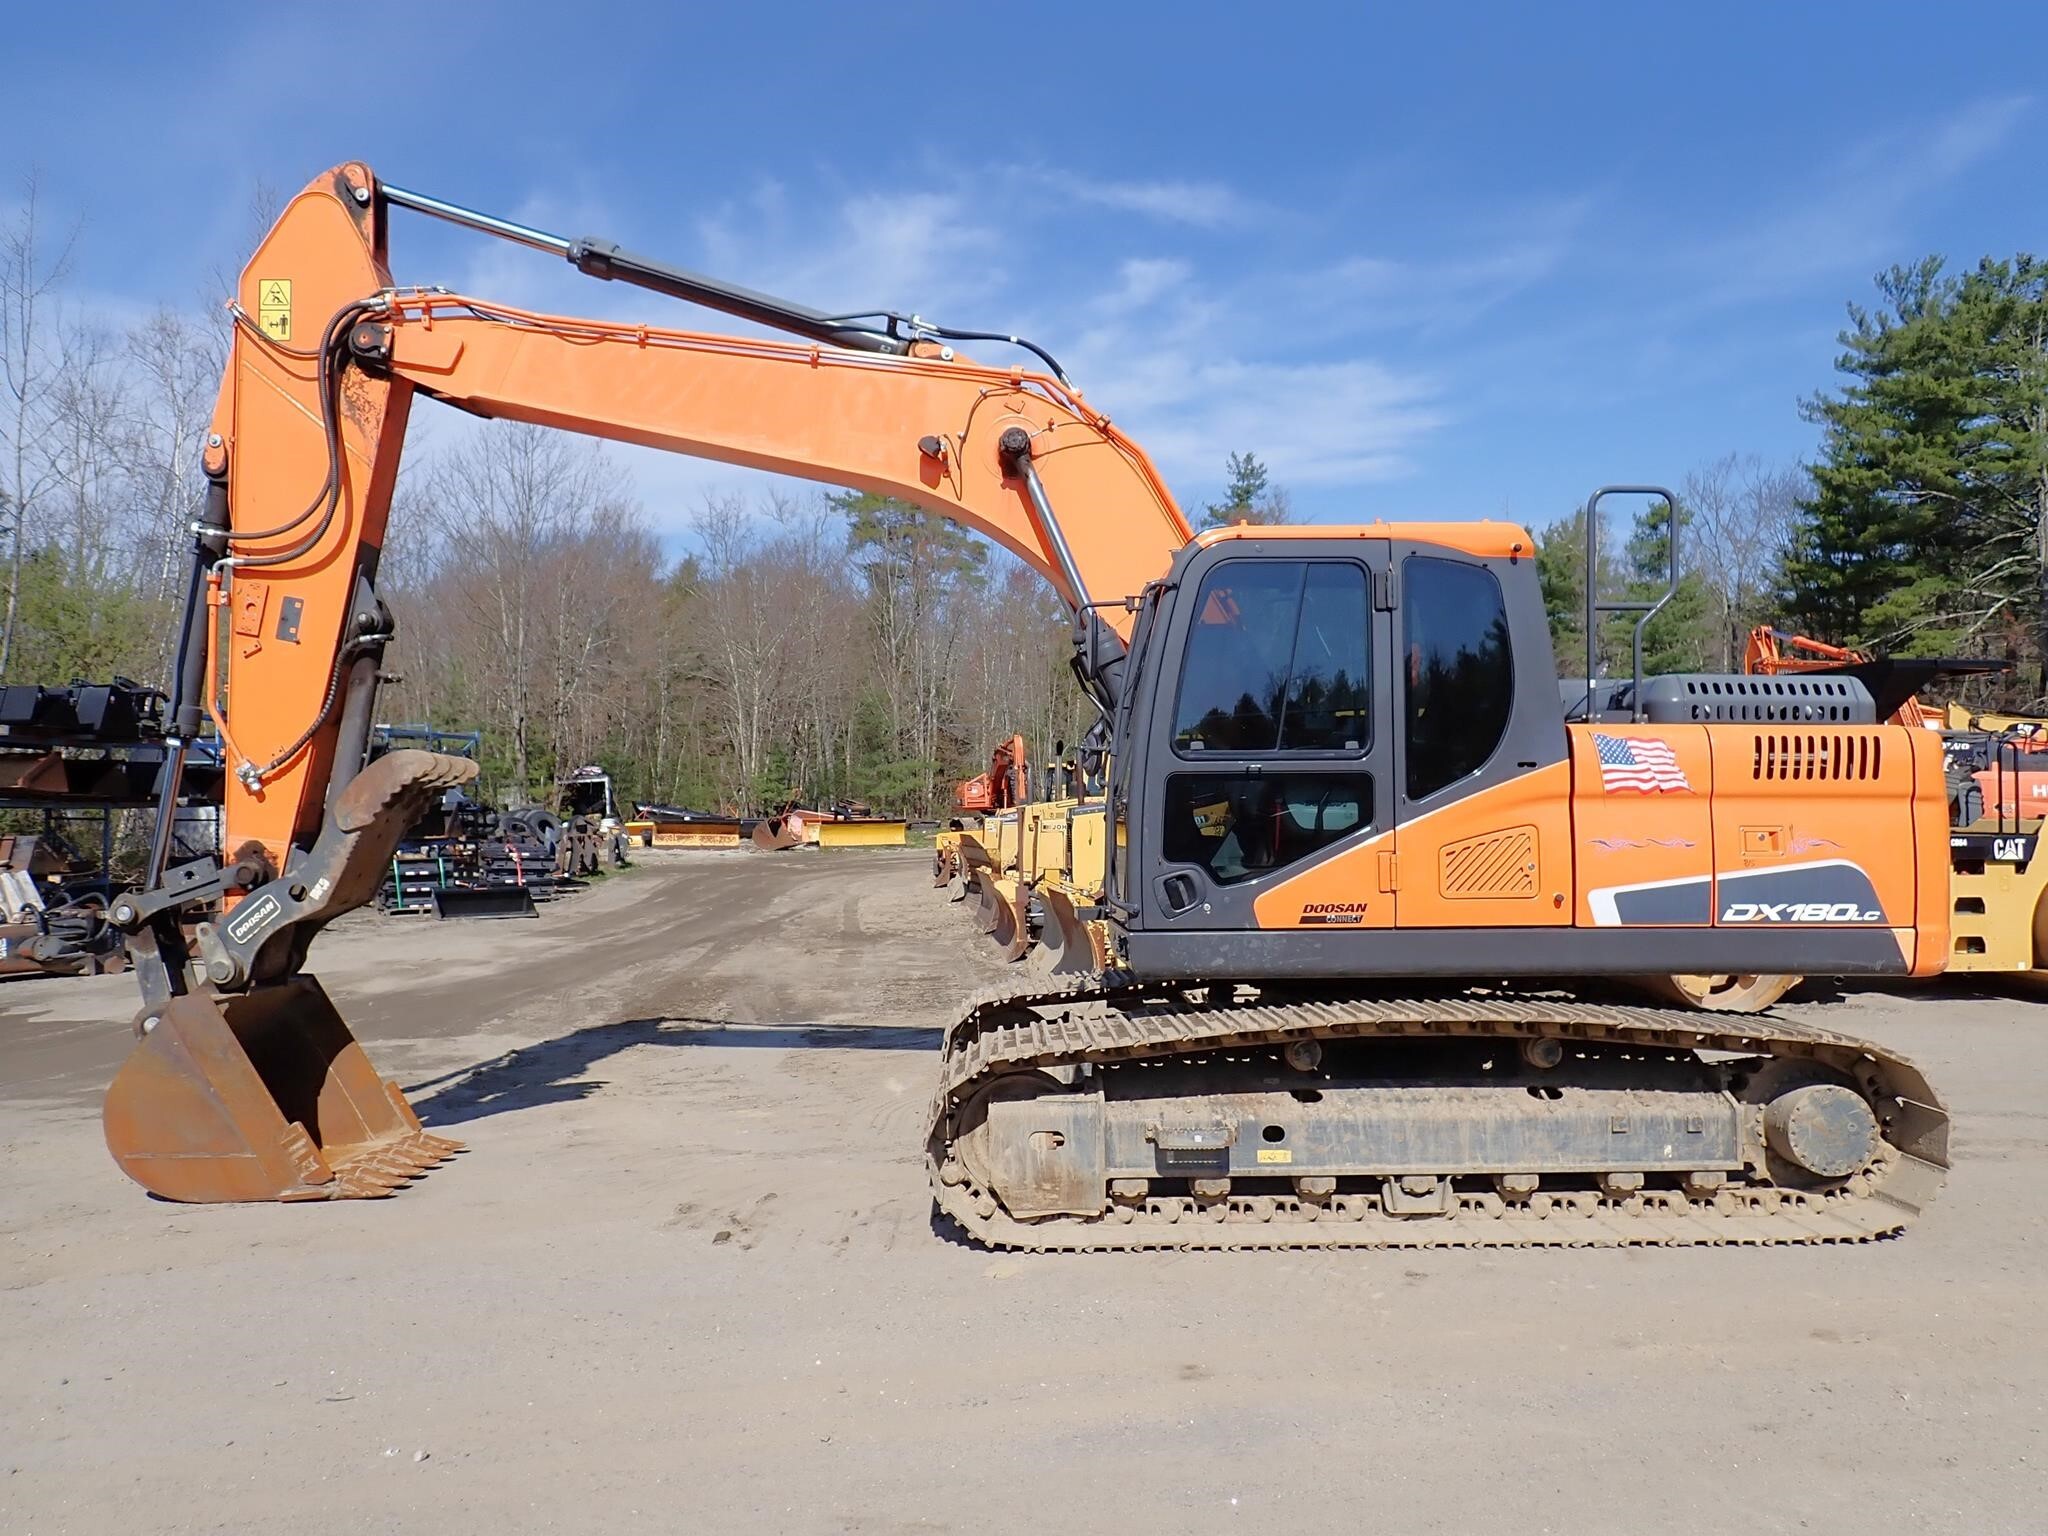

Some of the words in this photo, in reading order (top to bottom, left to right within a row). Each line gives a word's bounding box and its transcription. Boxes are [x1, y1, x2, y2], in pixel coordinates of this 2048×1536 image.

[1993, 838, 2026, 860] CAT
[1303, 903, 1368, 913] DOOSAN
[235, 901, 274, 937] DOOSAN
[1326, 915, 1361, 923] CONNECT
